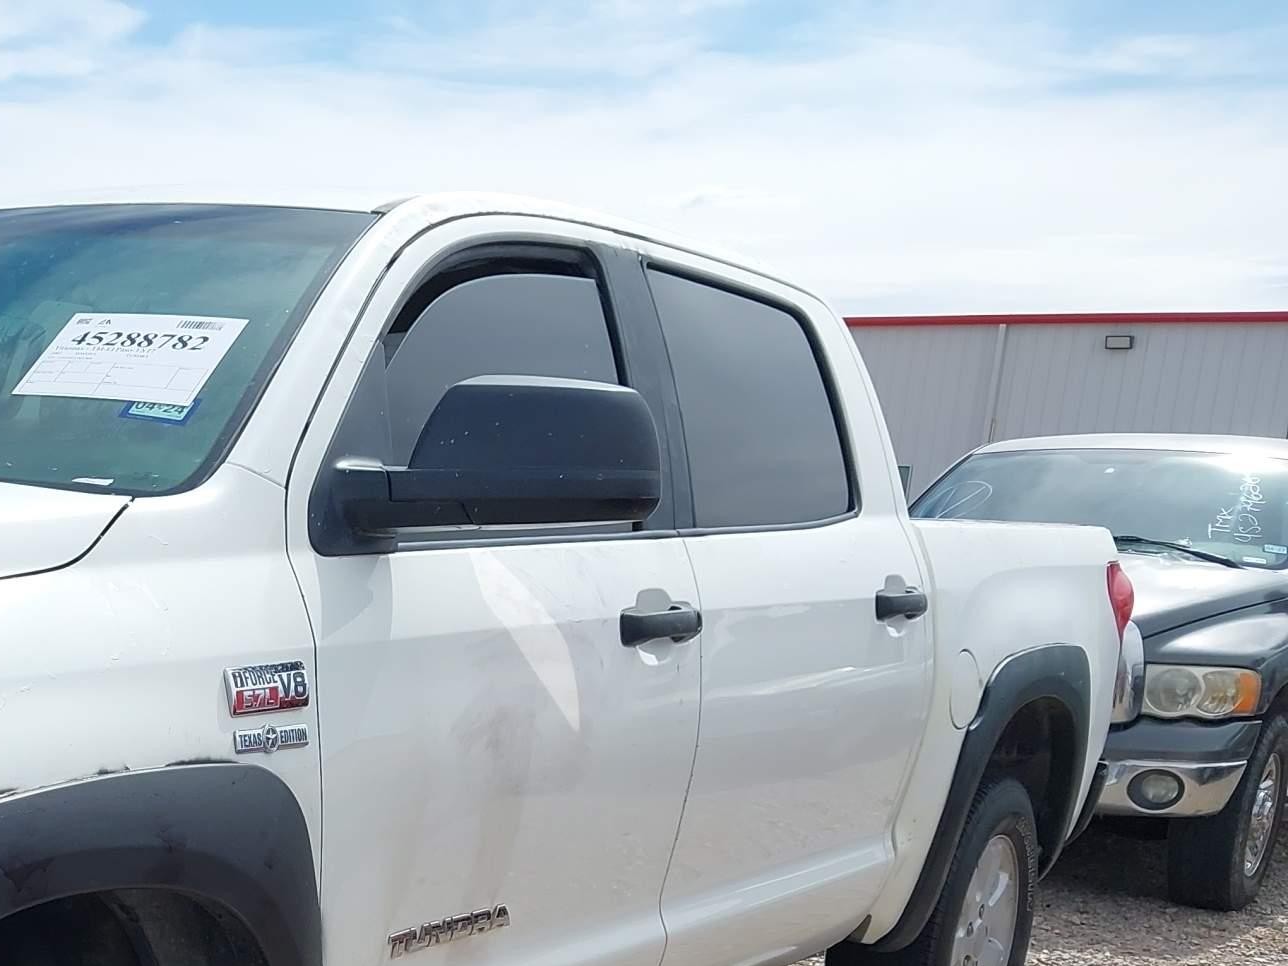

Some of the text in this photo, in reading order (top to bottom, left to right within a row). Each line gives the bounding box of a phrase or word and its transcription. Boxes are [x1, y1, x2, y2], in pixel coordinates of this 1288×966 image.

[71, 331, 210, 351] 45288782
[278, 671, 308, 700] V8
[238, 727, 308, 749] TEXAS EDITION
[387, 903, 511, 960] TUNDRA
